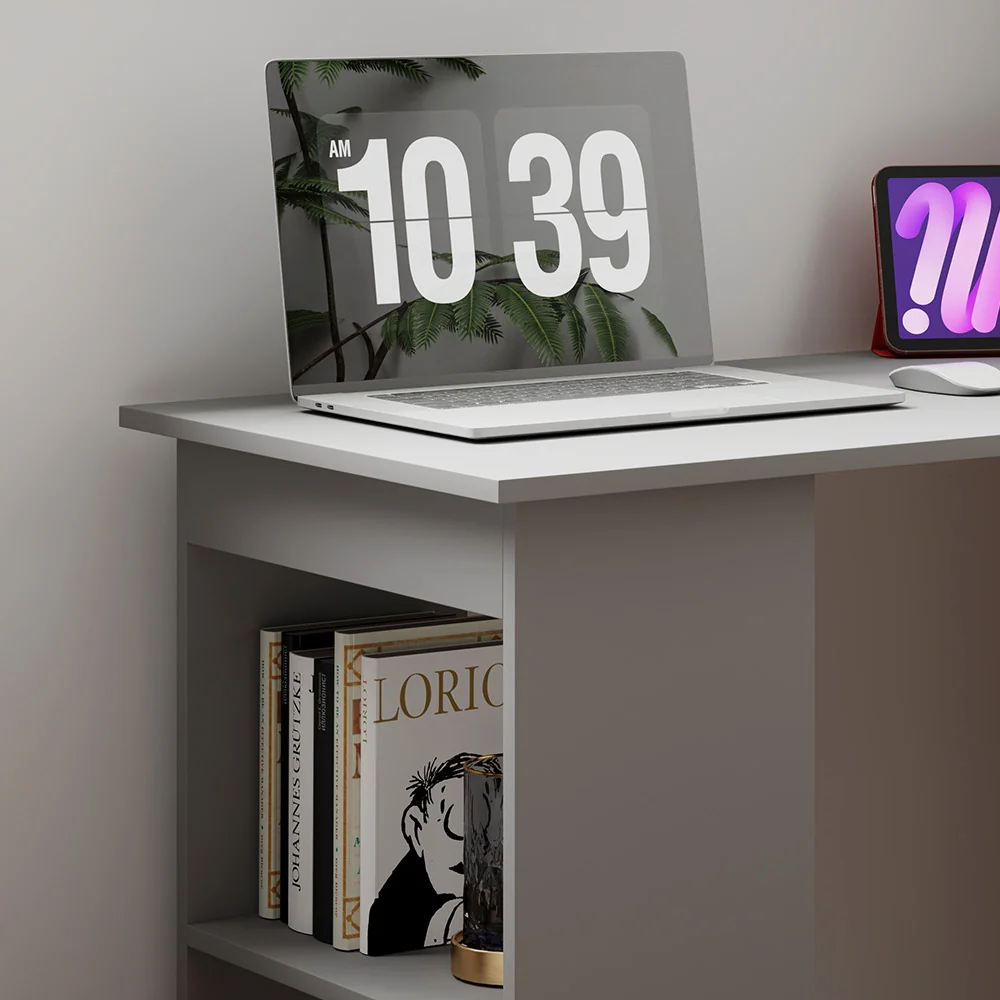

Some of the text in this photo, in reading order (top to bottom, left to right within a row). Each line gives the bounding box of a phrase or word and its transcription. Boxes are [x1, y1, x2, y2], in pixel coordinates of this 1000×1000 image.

[329, 139, 351, 158] AM
[337, 129, 650, 305] 10 39
[373, 662, 503, 723] LORIO
[291, 671, 301, 892] JOHANNES GRÜTZKE
